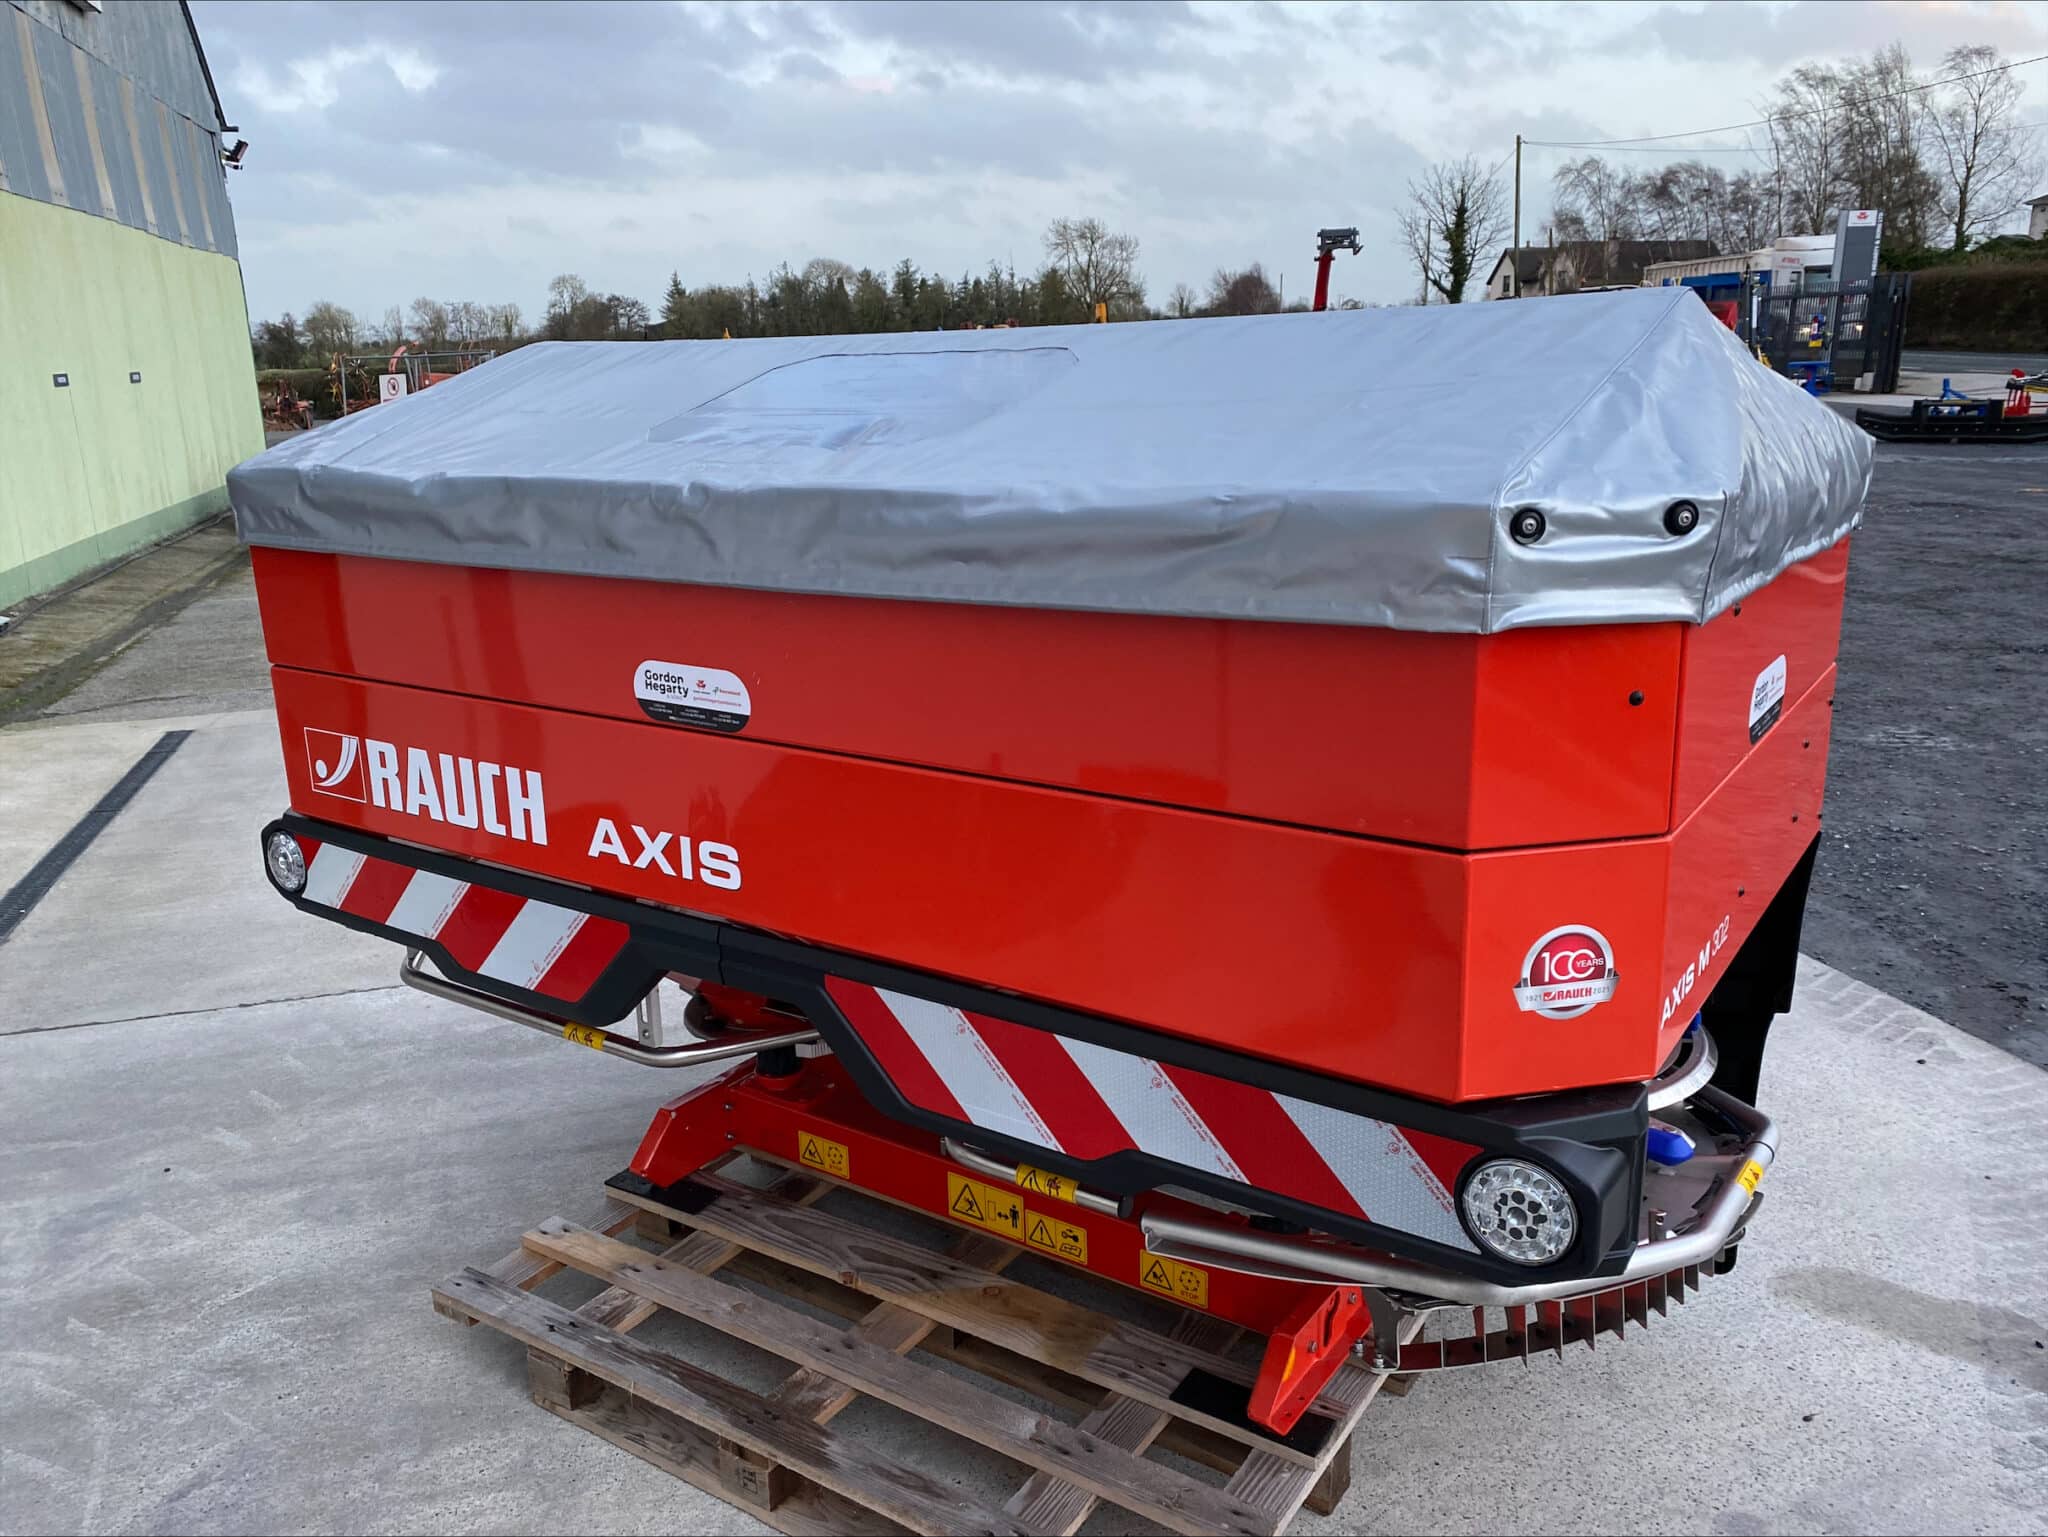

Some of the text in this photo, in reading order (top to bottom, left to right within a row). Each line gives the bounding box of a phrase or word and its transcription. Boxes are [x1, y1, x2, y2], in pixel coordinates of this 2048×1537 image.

[644, 670, 684, 684] Gordon
[645, 680, 689, 698] Hegarty
[365, 738, 548, 846] RAUCH
[588, 818, 742, 890] AXIS
[1576, 957, 1604, 968] YEARS
[1556, 987, 1592, 1001] RAUCH
[1660, 962, 1695, 1031] AXIS
[1698, 940, 1711, 977] M
